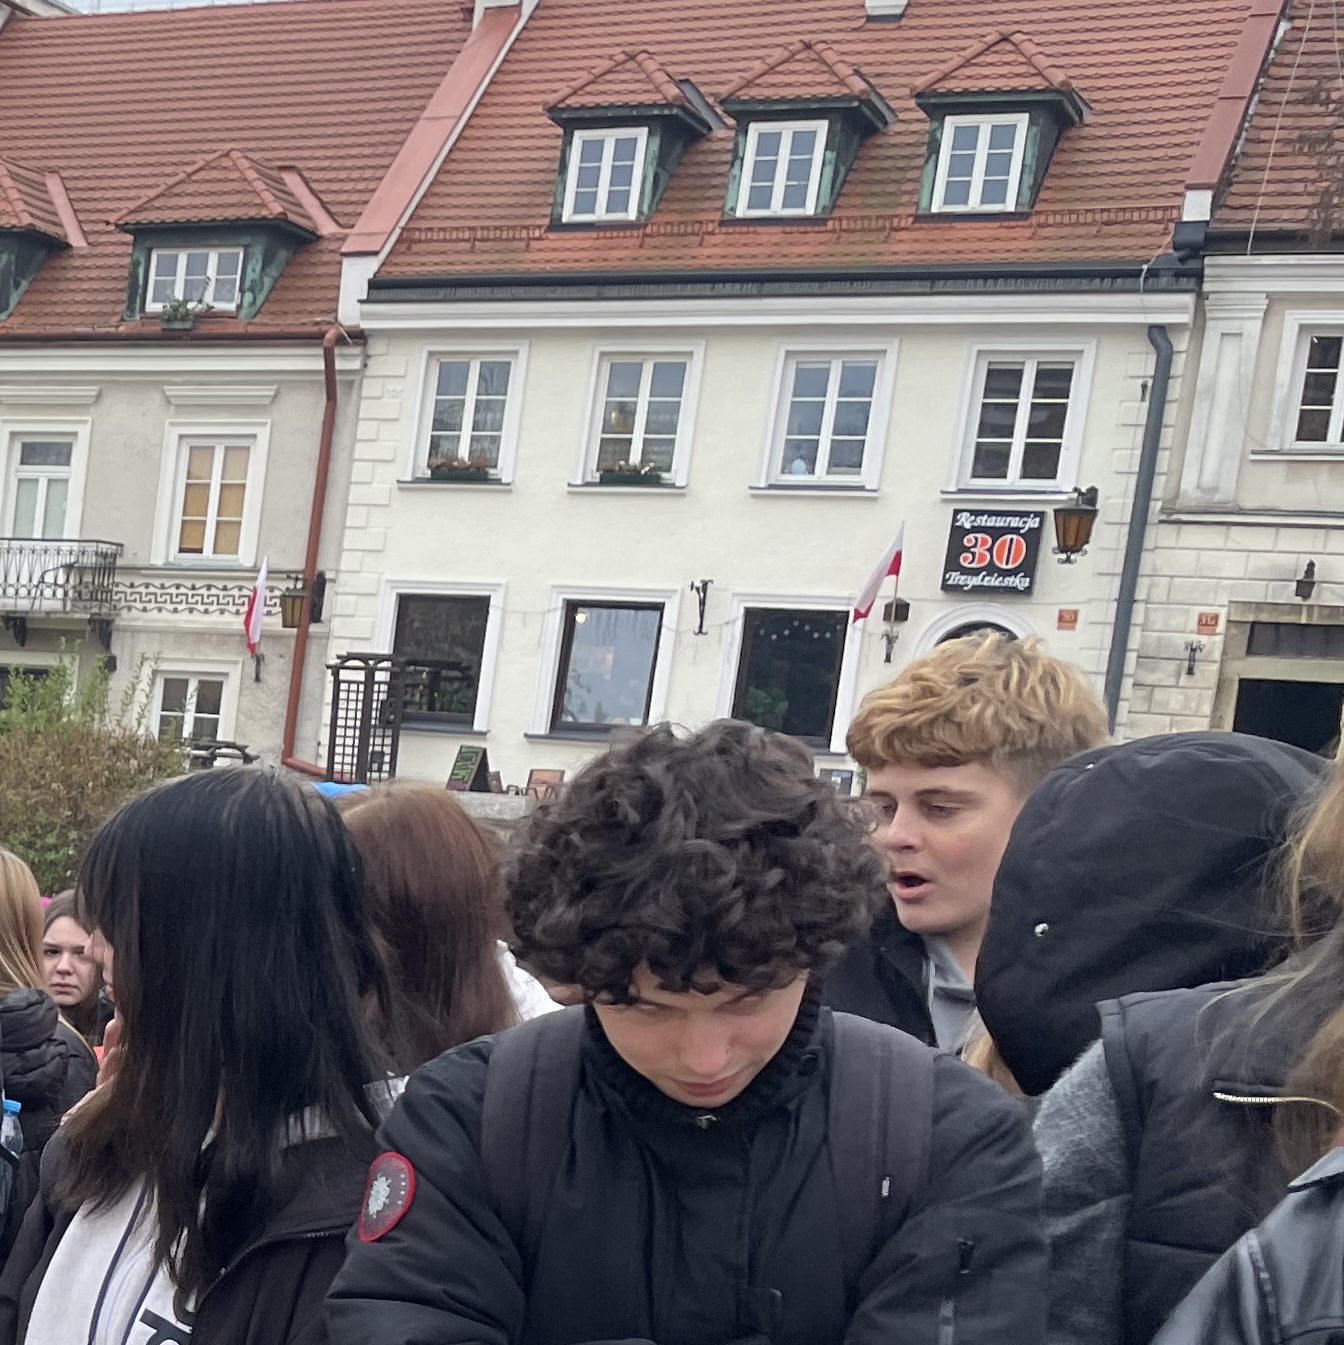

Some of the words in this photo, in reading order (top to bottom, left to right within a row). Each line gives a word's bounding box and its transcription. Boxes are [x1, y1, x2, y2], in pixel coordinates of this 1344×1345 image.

[955, 511, 1041, 534] Restauracja
[959, 533, 1027, 570] 30
[945, 570, 1031, 591] Trzydziestka
